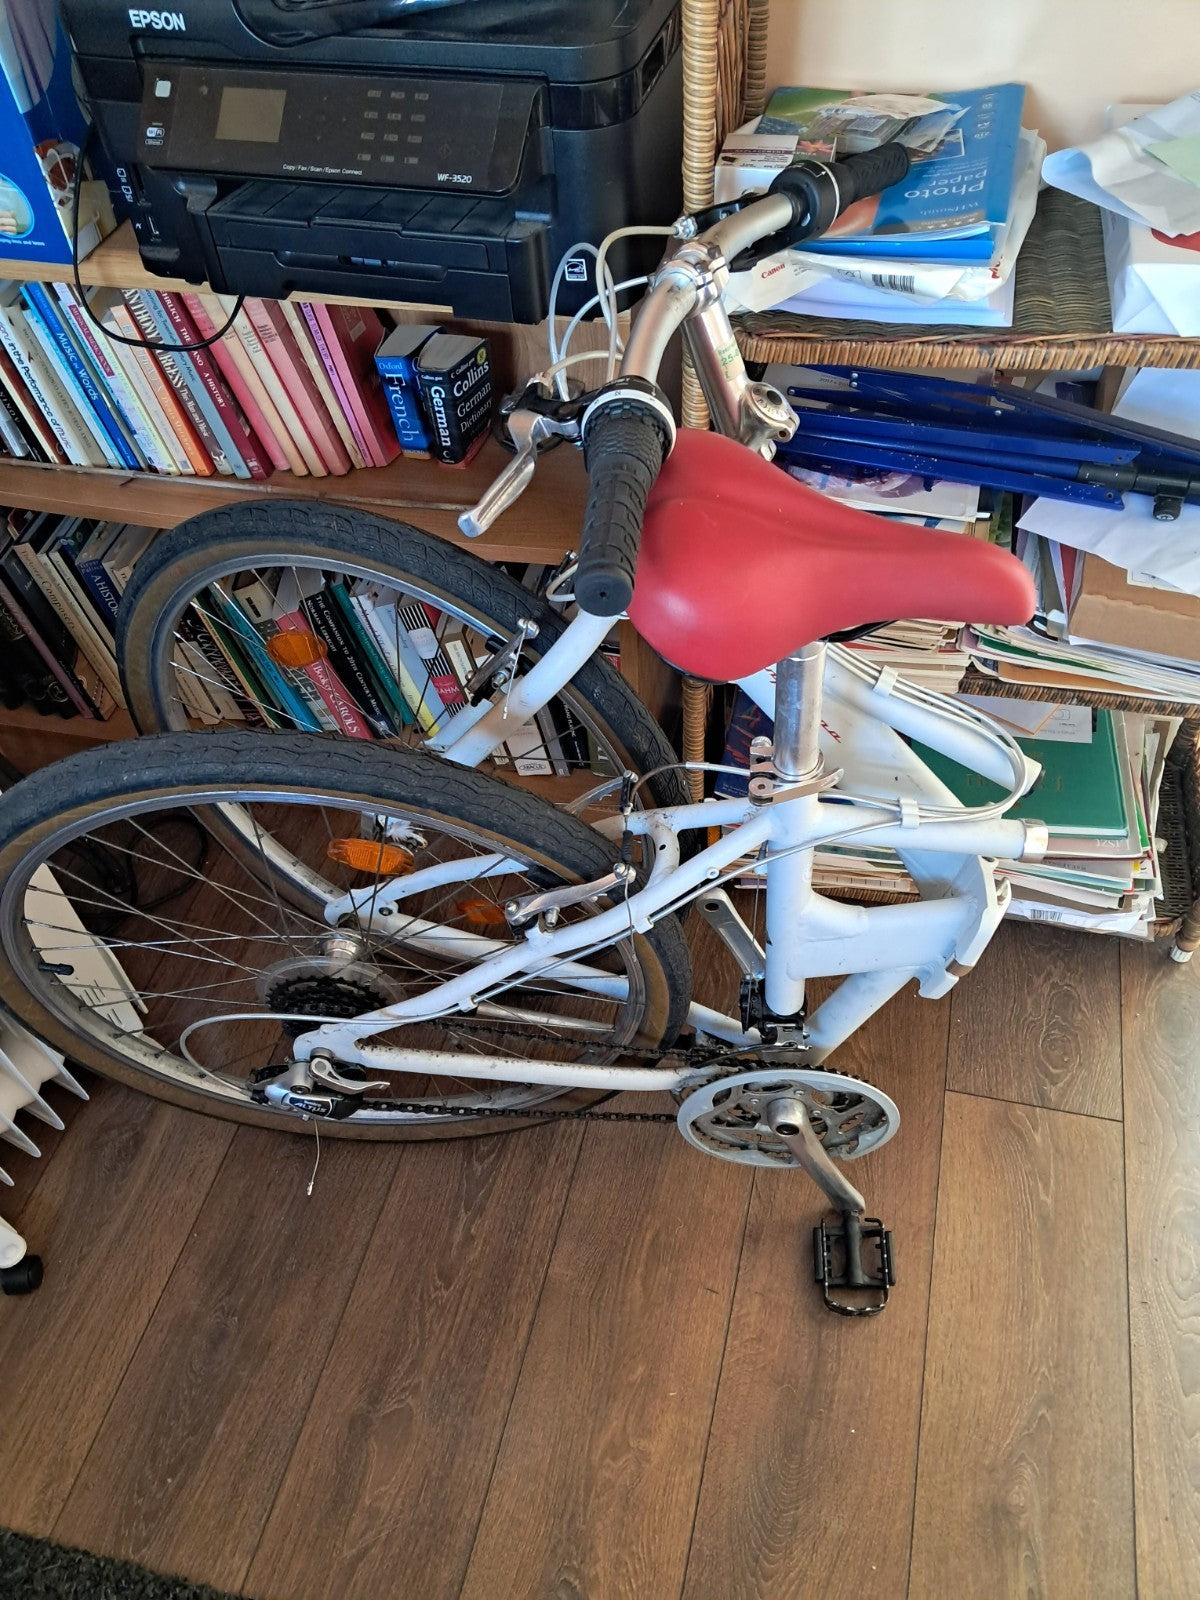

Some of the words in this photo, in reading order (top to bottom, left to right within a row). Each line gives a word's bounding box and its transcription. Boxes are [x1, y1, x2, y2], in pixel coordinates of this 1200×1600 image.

[128, 9, 186, 31] EPSON
[437, 173, 472, 184] WF-3520
[929, 168, 988, 186] paper
[761, 263, 786, 280] Canon
[70, 306, 90, 335] MUSICAL
[86, 334, 102, 355] MEMO
[122, 288, 160, 340] ANTHONY
[152, 342, 187, 389] URGESS
[56, 332, 76, 364] Music
[78, 369, 99, 401] Words
[179, 326, 192, 343] THE
[206, 377, 226, 409] HISTORY
[378, 362, 403, 370] Oxford
[453, 361, 489, 397] Collins
[11, 347, 25, 365] the
[22, 364, 52, 416] Performance
[50, 416, 61, 429] of
[56, 426, 72, 450] Music
[385, 372, 420, 442] French
[430, 386, 452, 447] German
[457, 382, 492, 418] German
[460, 398, 492, 432] Dictionary
[91, 572, 100, 582] A
[41, 579, 76, 630] Composers
[304, 599, 324, 625] NORMAN
[318, 625, 338, 653] LEBRECHT
[314, 594, 326, 609] THE
[320, 609, 346, 646] COMPANION
[346, 654, 359, 671] 20TH
[353, 670, 374, 698] CENTURY
[368, 697, 383, 716] MUSIC
[314, 664, 328, 686] Book
[328, 688, 360, 734] CAROLS
[567, 720, 576, 738] PLAYNG
[294, 1102, 327, 1113] ALTUS
